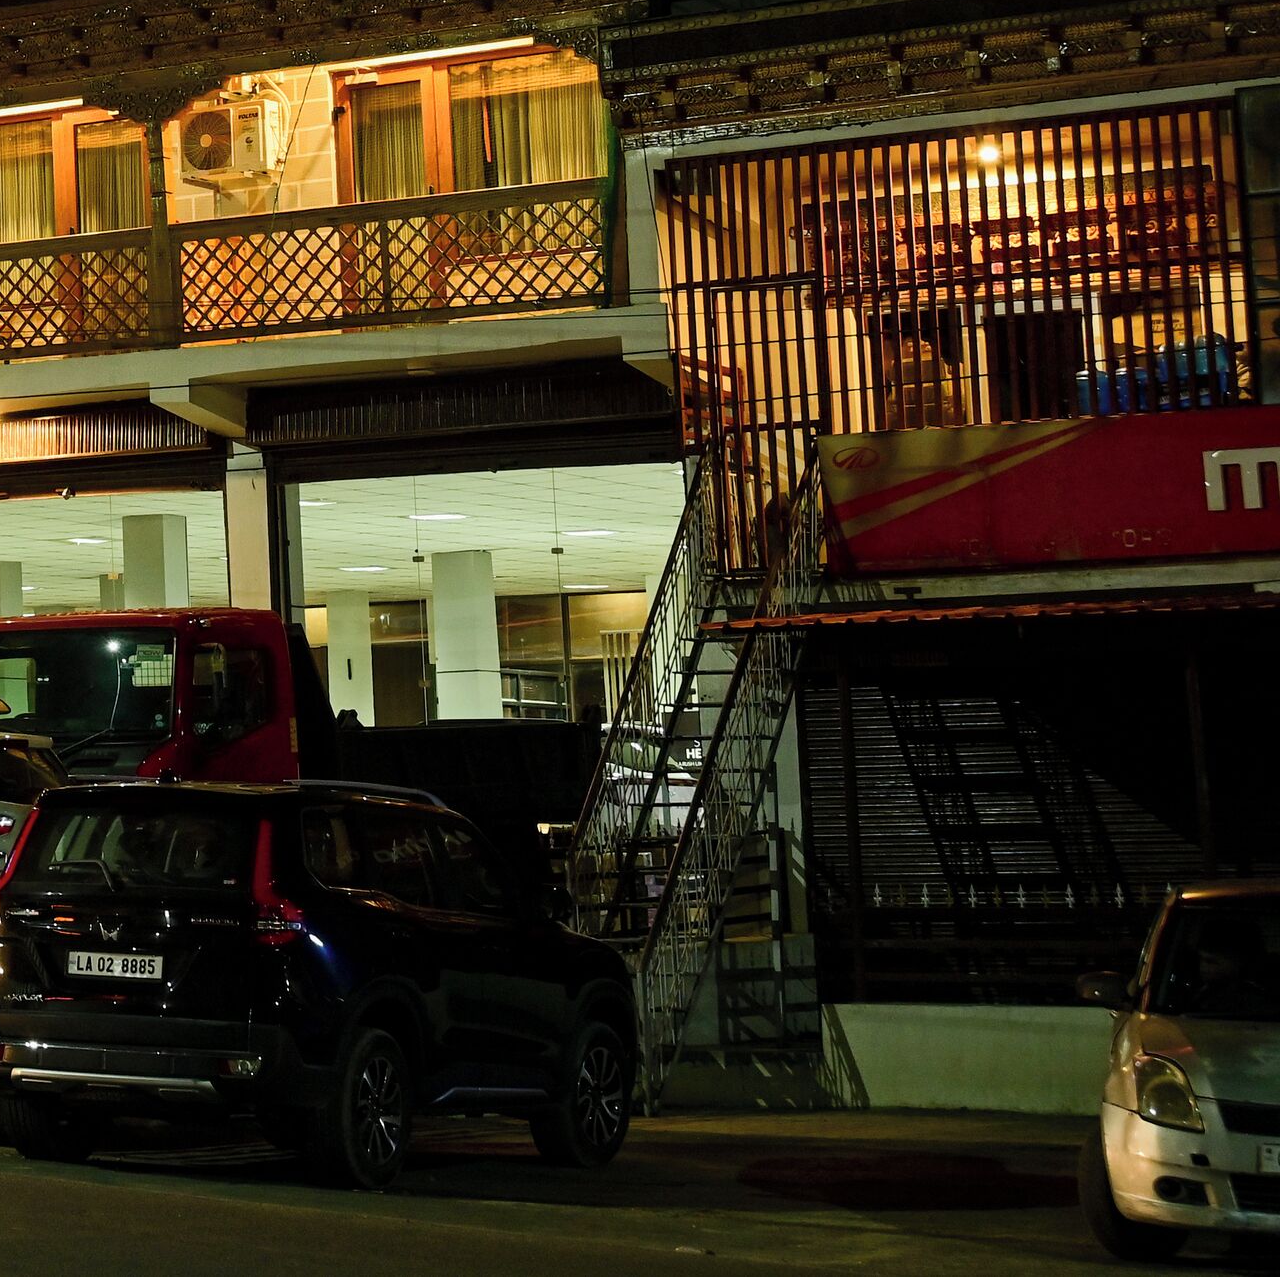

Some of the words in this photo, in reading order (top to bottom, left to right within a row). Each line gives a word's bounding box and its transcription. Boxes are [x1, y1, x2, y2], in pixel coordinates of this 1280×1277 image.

[76, 953, 93, 973] LA
[97, 954, 114, 973] 02
[121, 956, 156, 975] 8885
